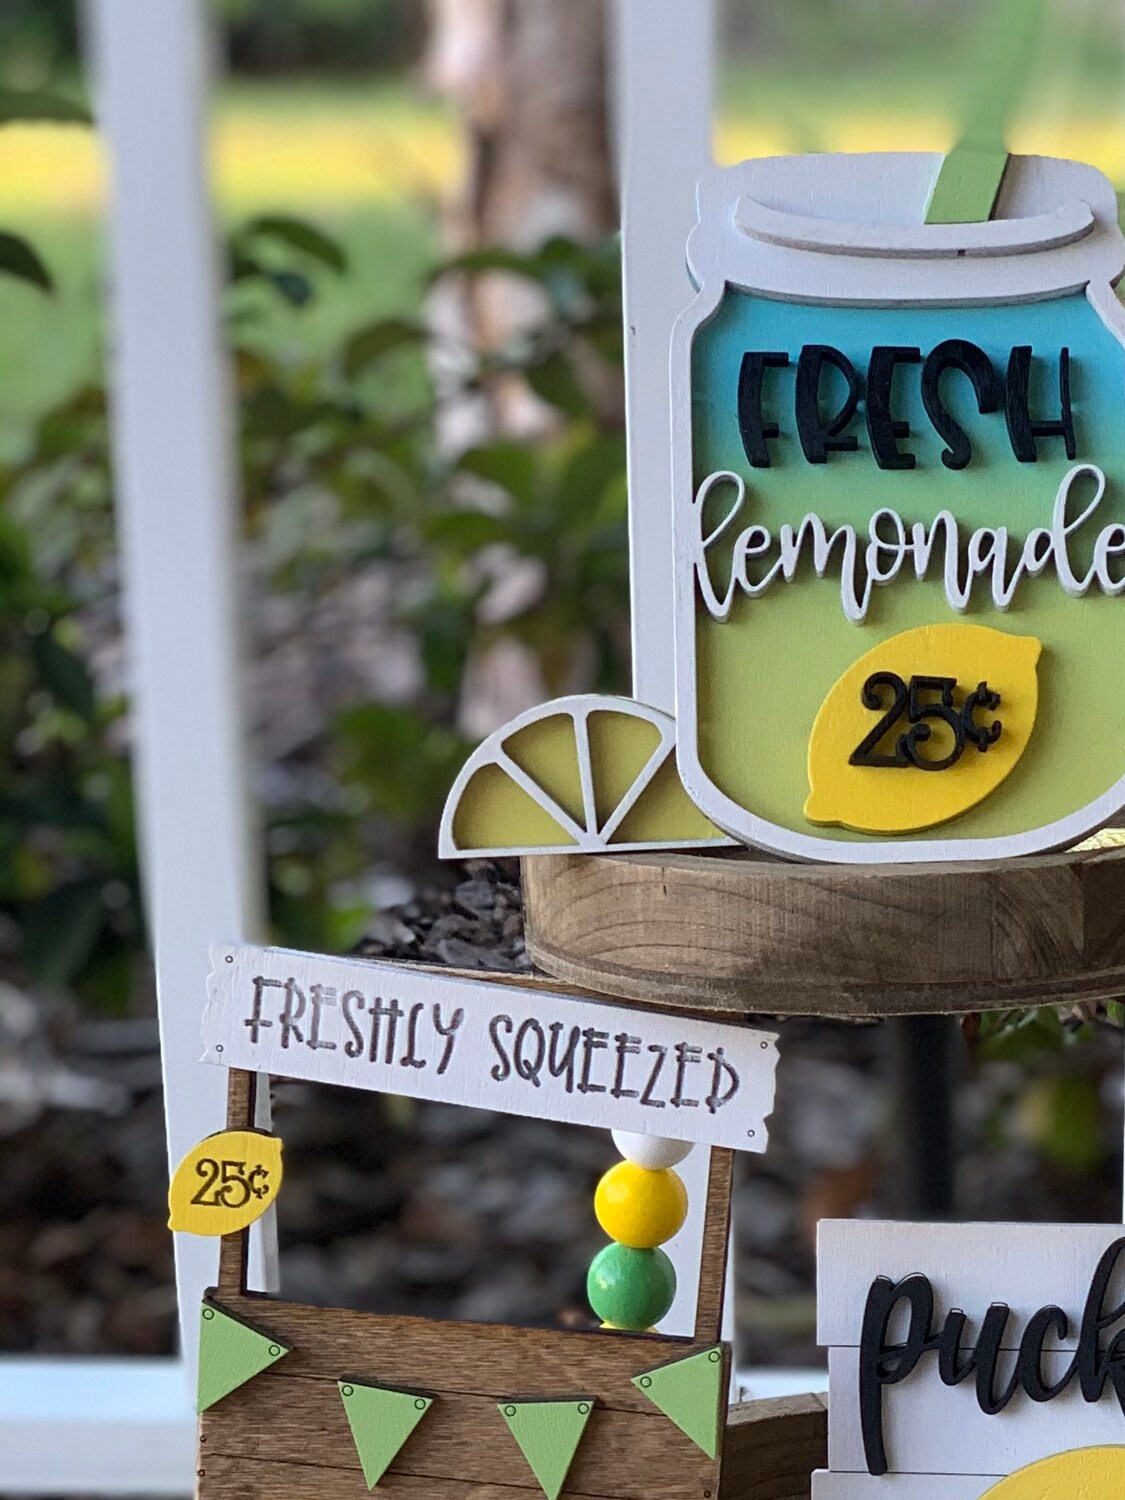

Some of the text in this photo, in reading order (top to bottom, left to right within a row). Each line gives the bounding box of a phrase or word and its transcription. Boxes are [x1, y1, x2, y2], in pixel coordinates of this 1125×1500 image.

[737, 339, 1077, 470] FRESH
[244, 975, 741, 1114] FRESHLY SQUEEZED
